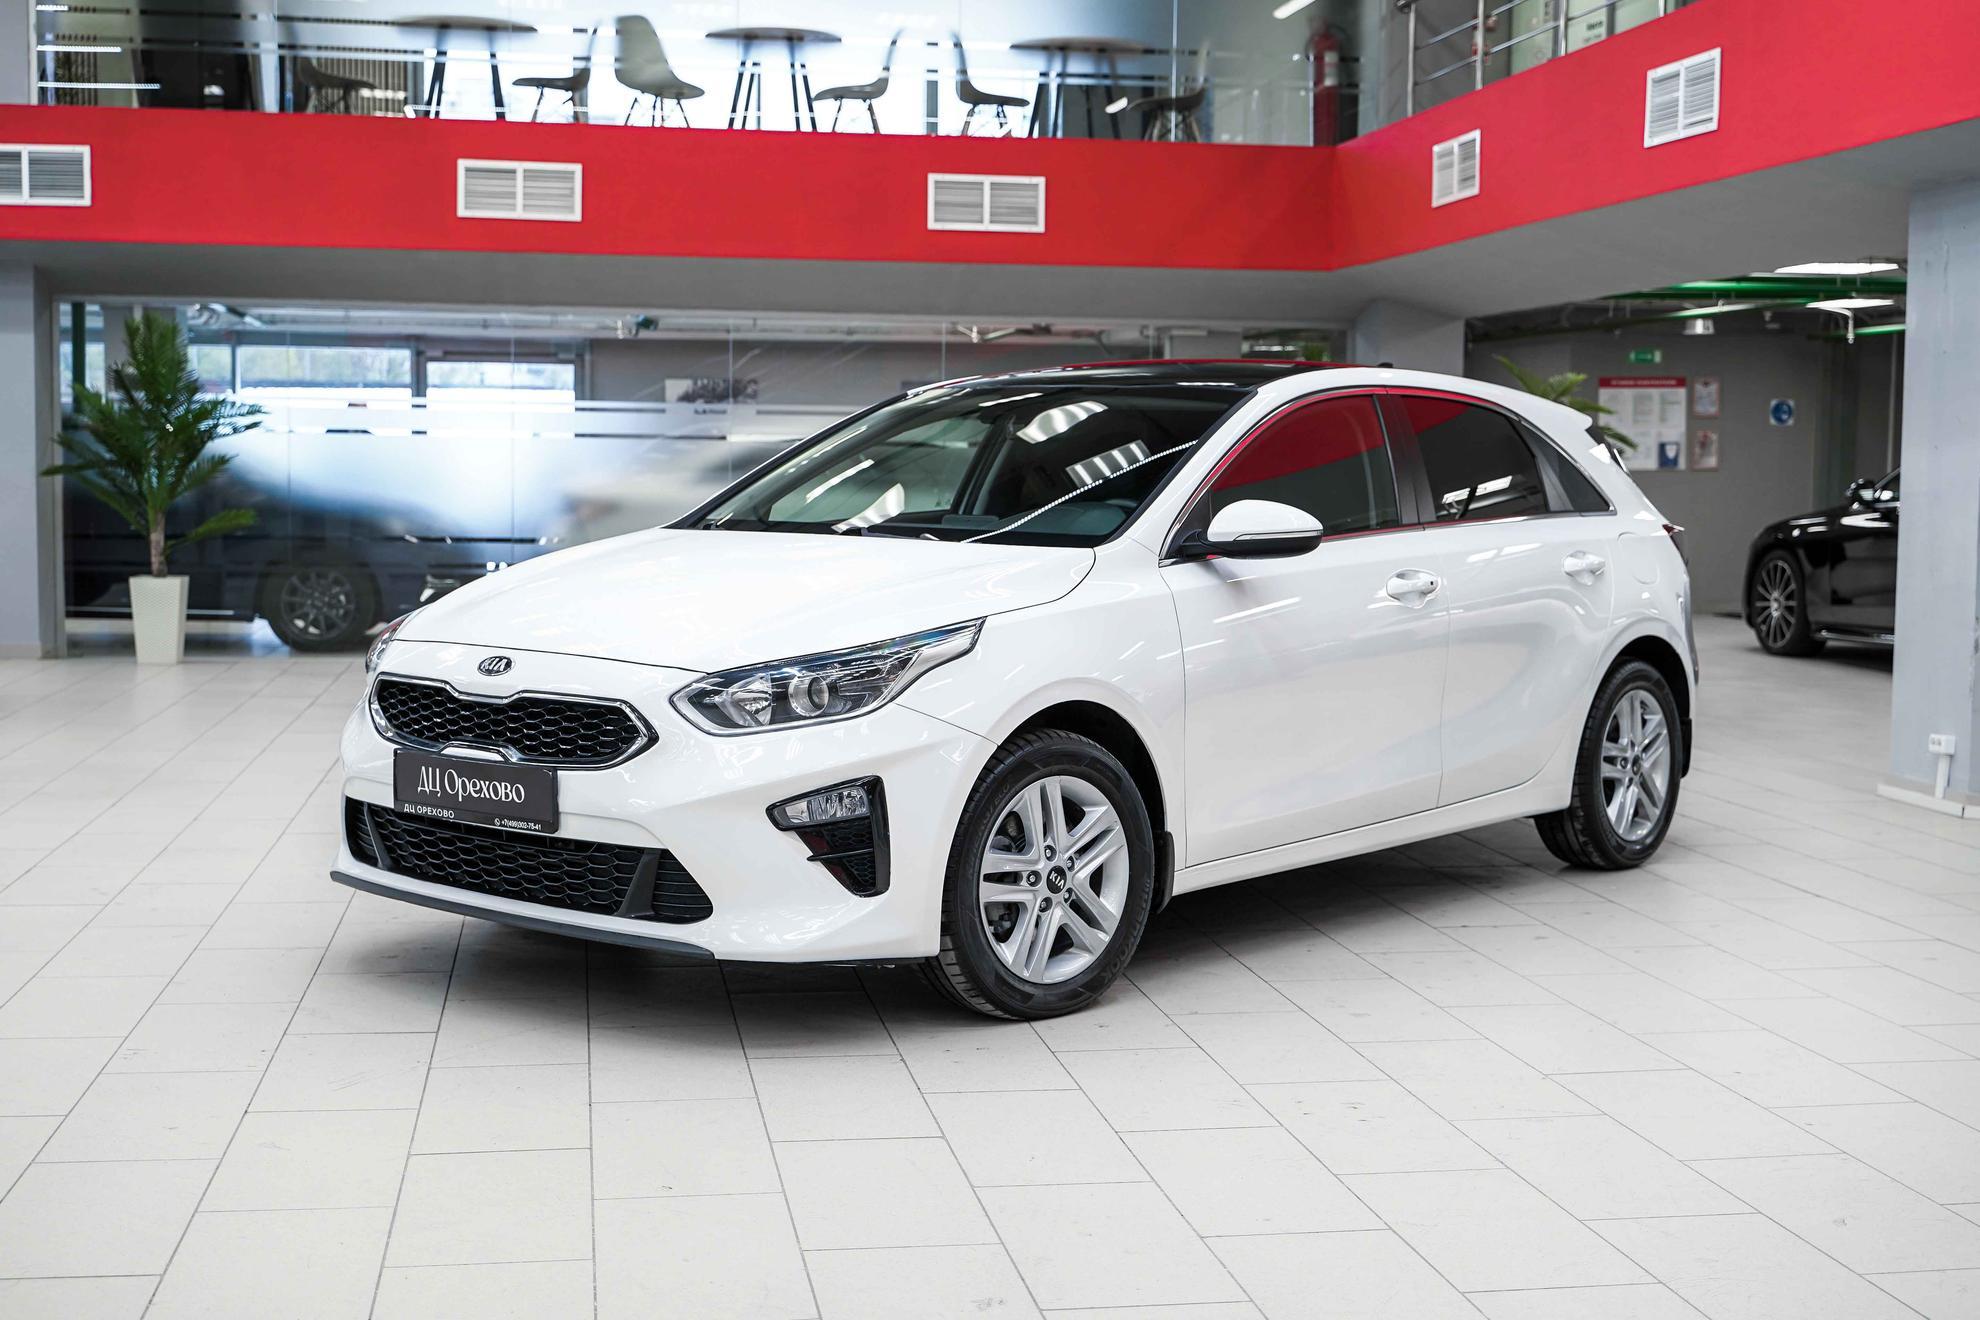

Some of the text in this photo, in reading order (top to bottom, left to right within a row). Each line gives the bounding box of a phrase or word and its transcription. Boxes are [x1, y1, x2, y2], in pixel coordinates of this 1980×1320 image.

[480, 657, 508, 671] KIA
[418, 766, 525, 803] ДЦ Орехово
[404, 803, 455, 819] ДЦ ОРЕХОВО
[1049, 870, 1065, 889] KIA
